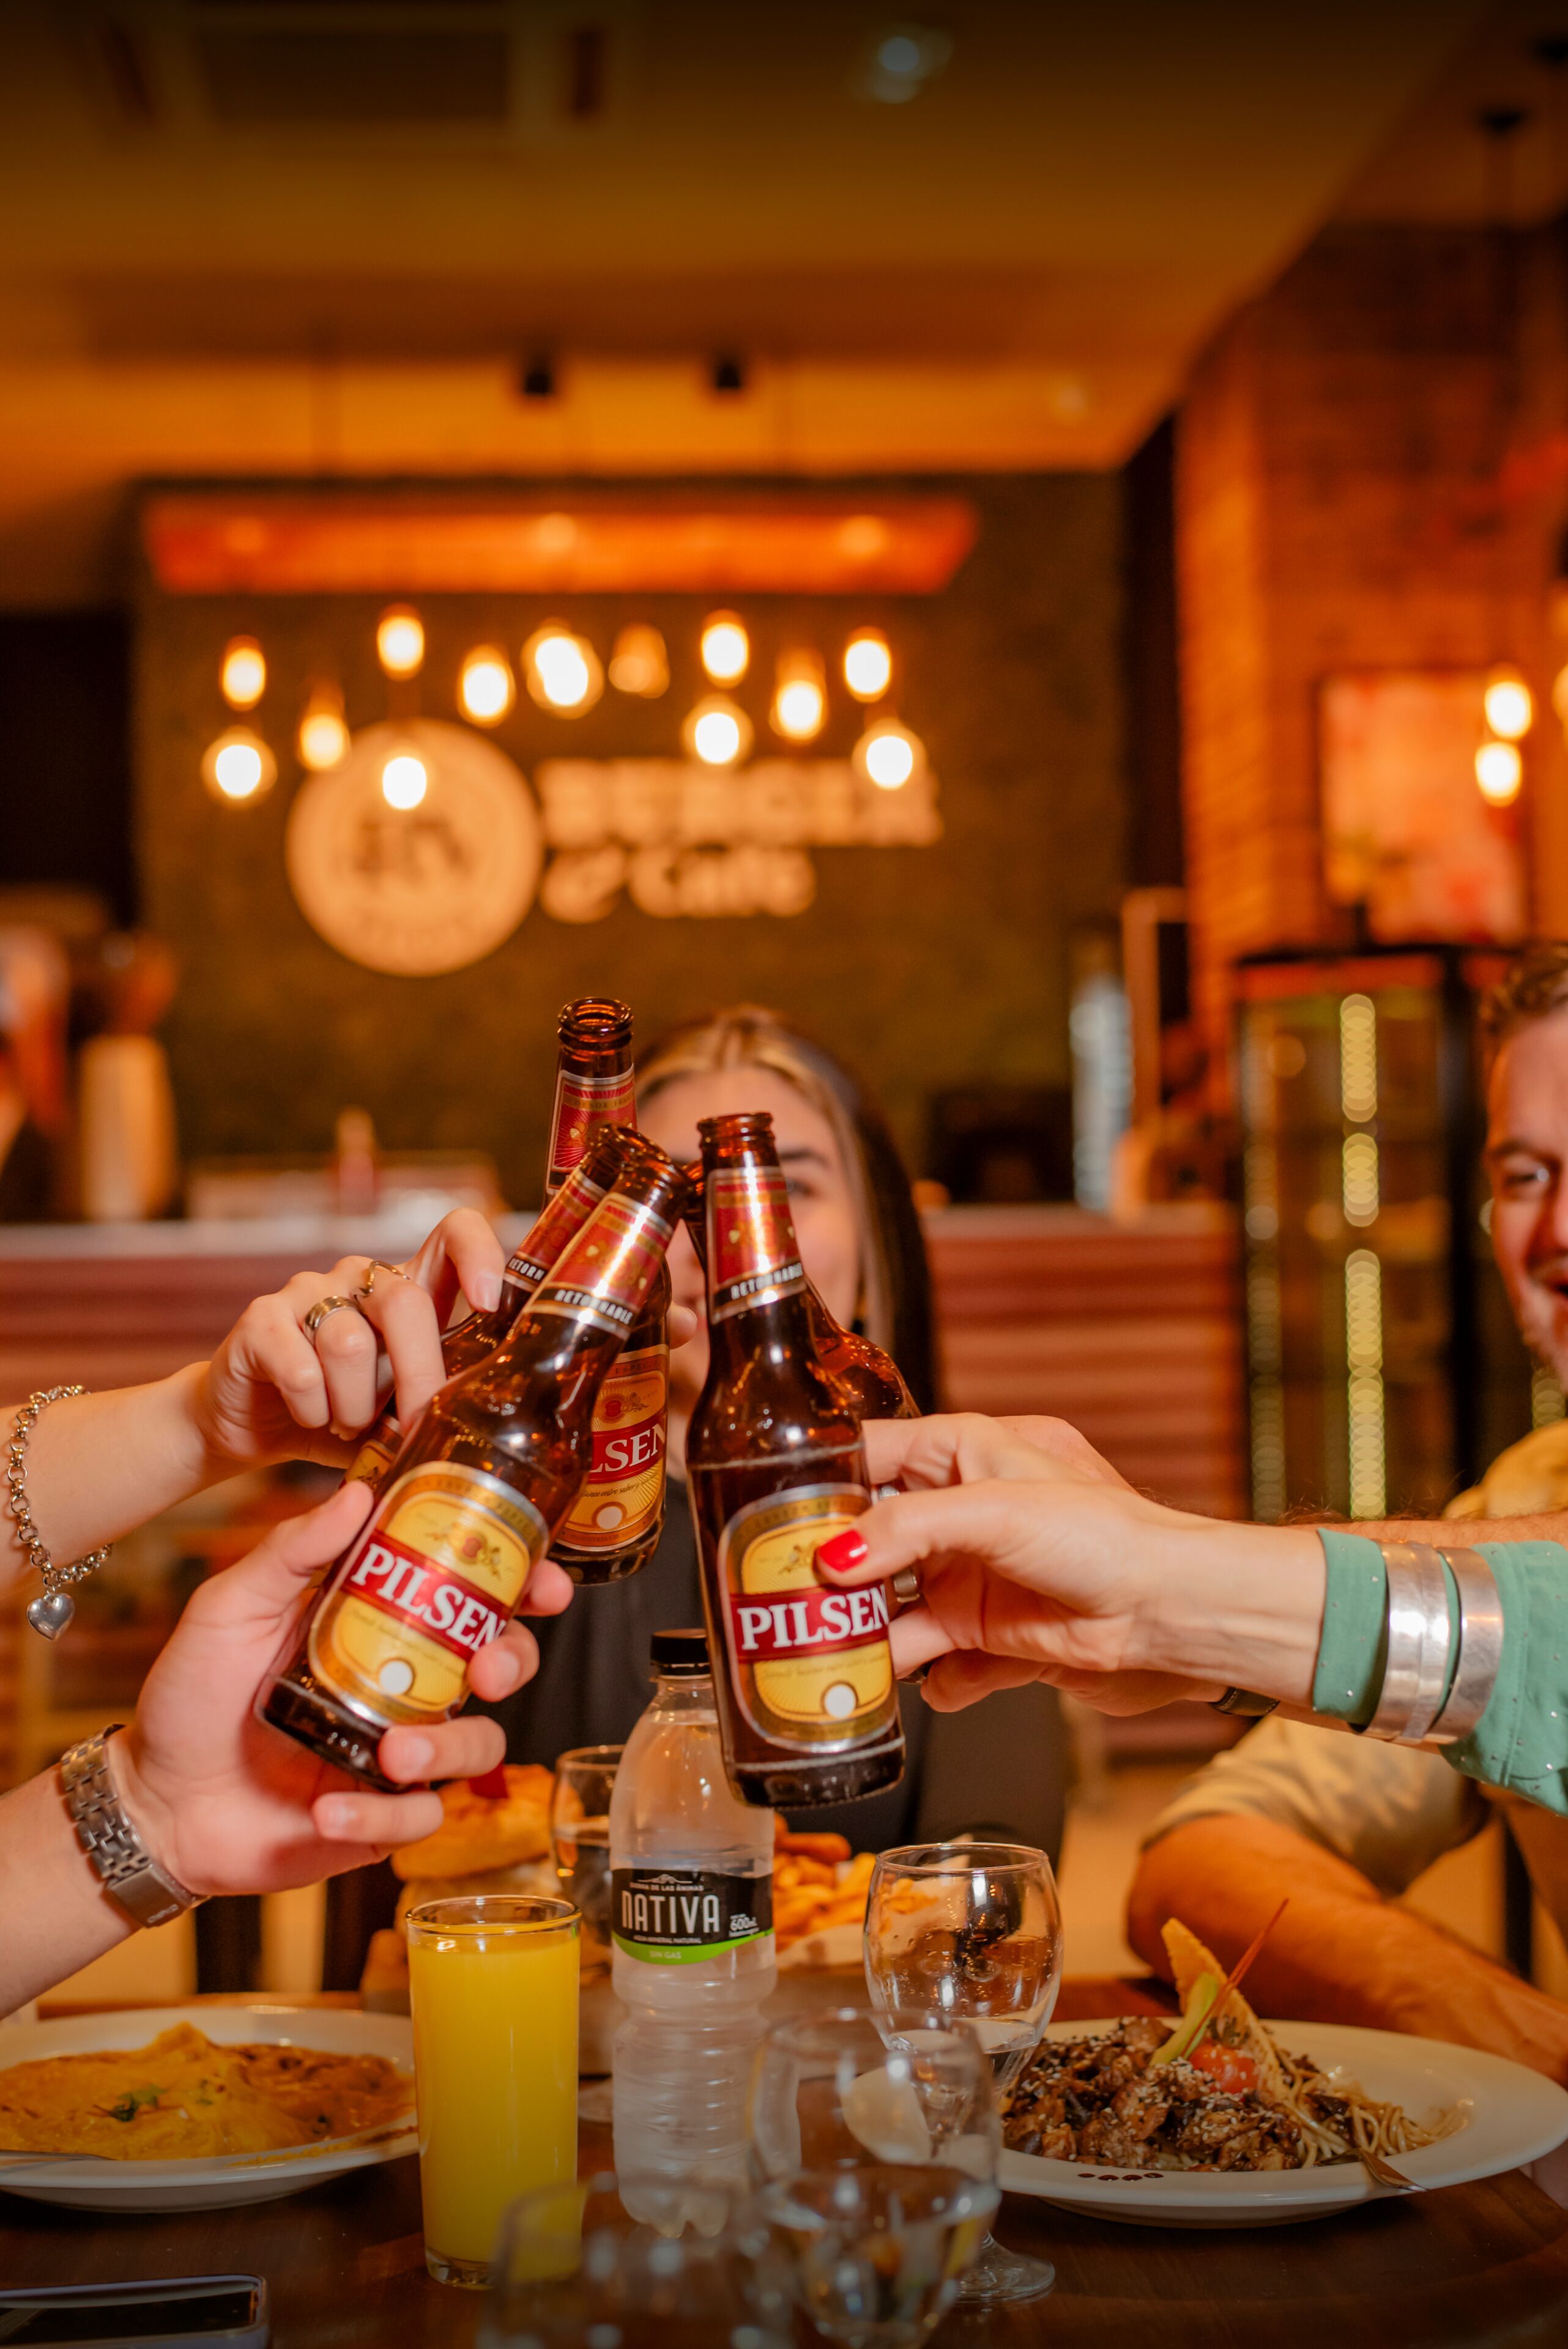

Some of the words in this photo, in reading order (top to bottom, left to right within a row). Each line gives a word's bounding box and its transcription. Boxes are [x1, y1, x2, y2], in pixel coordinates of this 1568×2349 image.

[508, 1258, 545, 1281] RETORN
[554, 1289, 633, 1325] RETORNABLE
[589, 1423, 665, 1472] SEN
[351, 1543, 507, 1652] PILSEN
[737, 1584, 889, 1650] PILSEN
[622, 1890, 720, 1934] NATIVA
